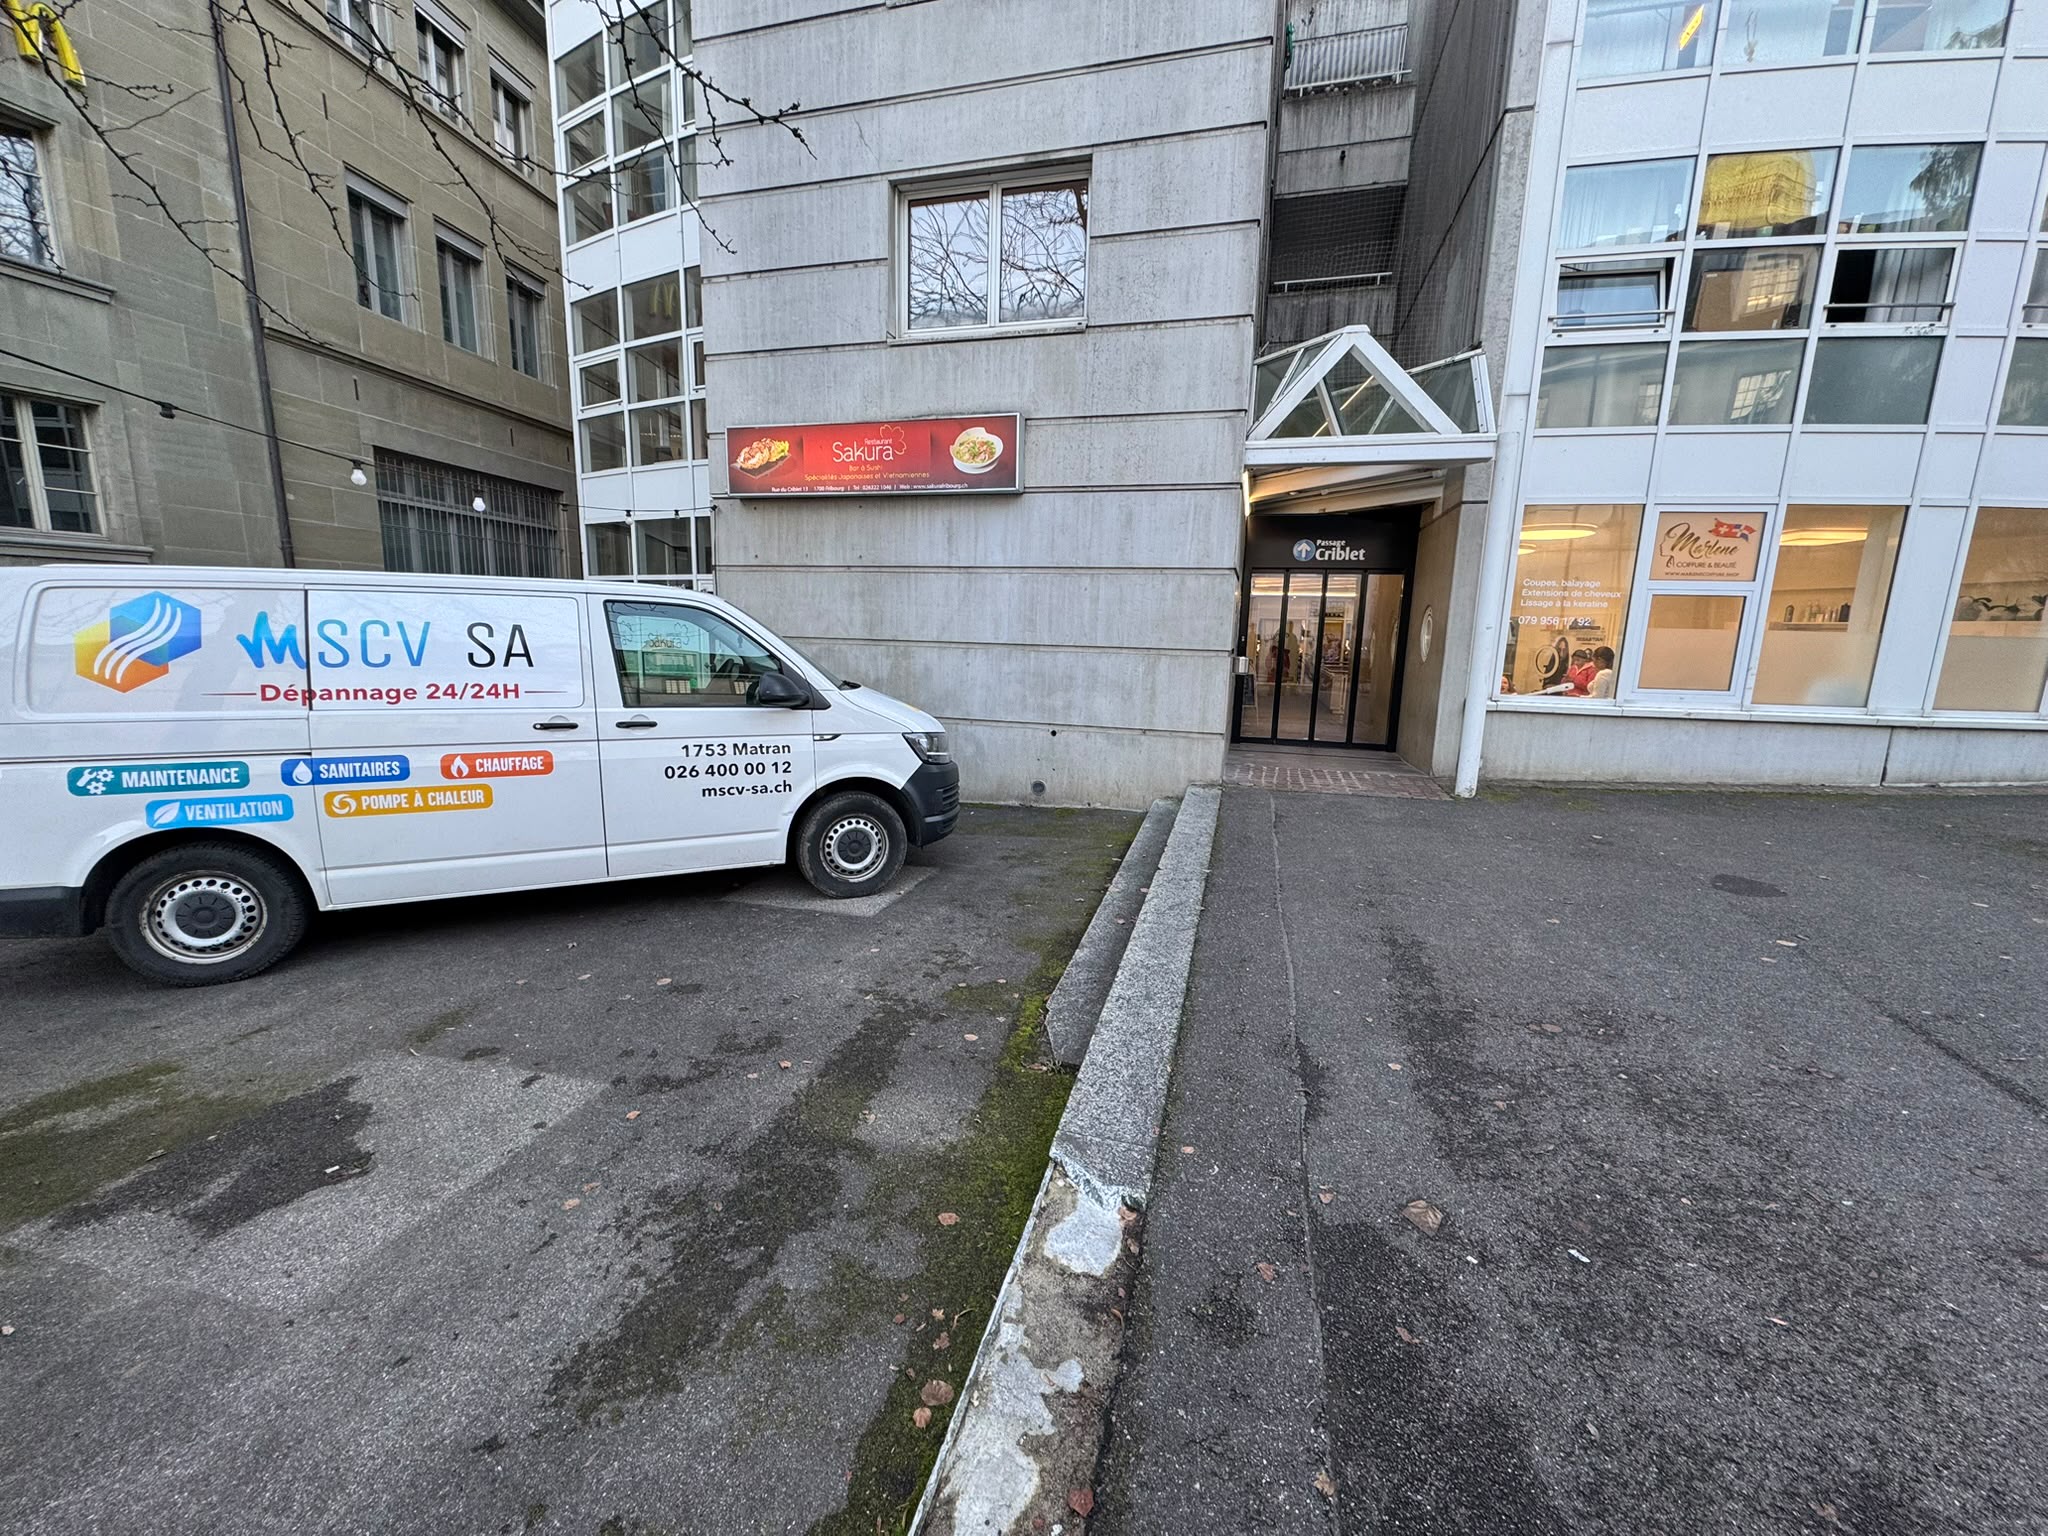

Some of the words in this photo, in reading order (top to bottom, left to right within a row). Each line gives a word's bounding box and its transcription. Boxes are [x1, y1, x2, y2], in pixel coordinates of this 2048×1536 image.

[832, 440, 894, 463] Sakura
[849, 464, 859, 472] Bar
[866, 463, 882, 471] Sushi
[883, 471, 930, 479] Vietnamiennes
[1316, 539, 1346, 547] Passage
[1666, 522, 1740, 560] Marlene
[1315, 546, 1366, 561] Criblet
[1561, 579, 1601, 589] balayage
[1521, 588, 1569, 597] Extensions
[1570, 589, 1582, 598] de
[1584, 589, 1622, 598] cheveux
[1520, 599, 1554, 609] Lissage
[1518, 616, 1538, 625] 079
[1577, 617, 1591, 626] 92
[236, 611, 431, 669] MSCV
[466, 621, 534, 668] SA
[260, 684, 418, 706] Dépannage
[425, 682, 520, 700] 24/24H
[681, 743, 727, 758] 1753
[732, 742, 791, 756] Matran
[319, 761, 401, 779] SANITAIRES
[475, 756, 545, 773] CHAUFFAGE
[664, 765, 700, 779] 026
[705, 763, 739, 777] 400
[744, 762, 766, 775] 00
[771, 761, 792, 774] 12
[121, 768, 240, 788] MAINTENANCE
[702, 780, 793, 797] mscv-sa.ch
[361, 793, 409, 810] POMPE
[414, 790, 424, 807] À
[427, 789, 485, 806] CHALEUR
[184, 800, 284, 821] VENTILATION
